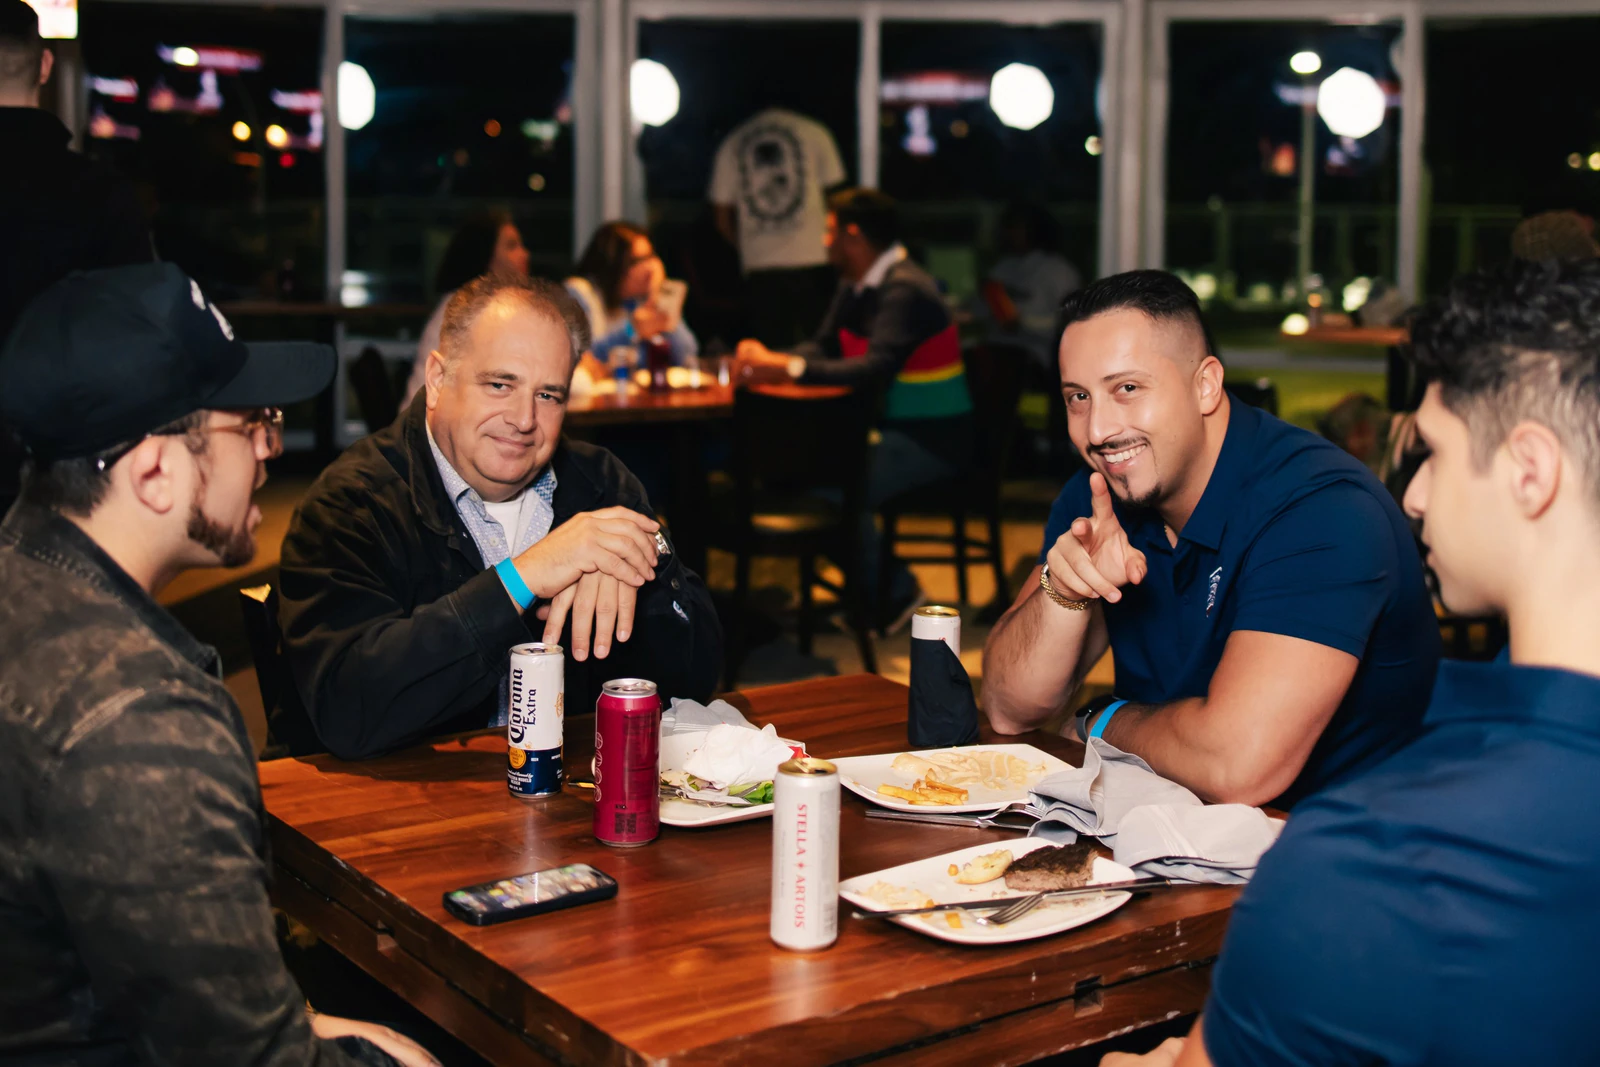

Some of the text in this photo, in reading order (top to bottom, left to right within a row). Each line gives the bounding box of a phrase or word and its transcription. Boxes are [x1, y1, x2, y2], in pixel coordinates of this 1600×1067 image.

[510, 668, 527, 743] Corona
[524, 689, 537, 725] Extra
[795, 804, 808, 927] STELLA ARTOIS
